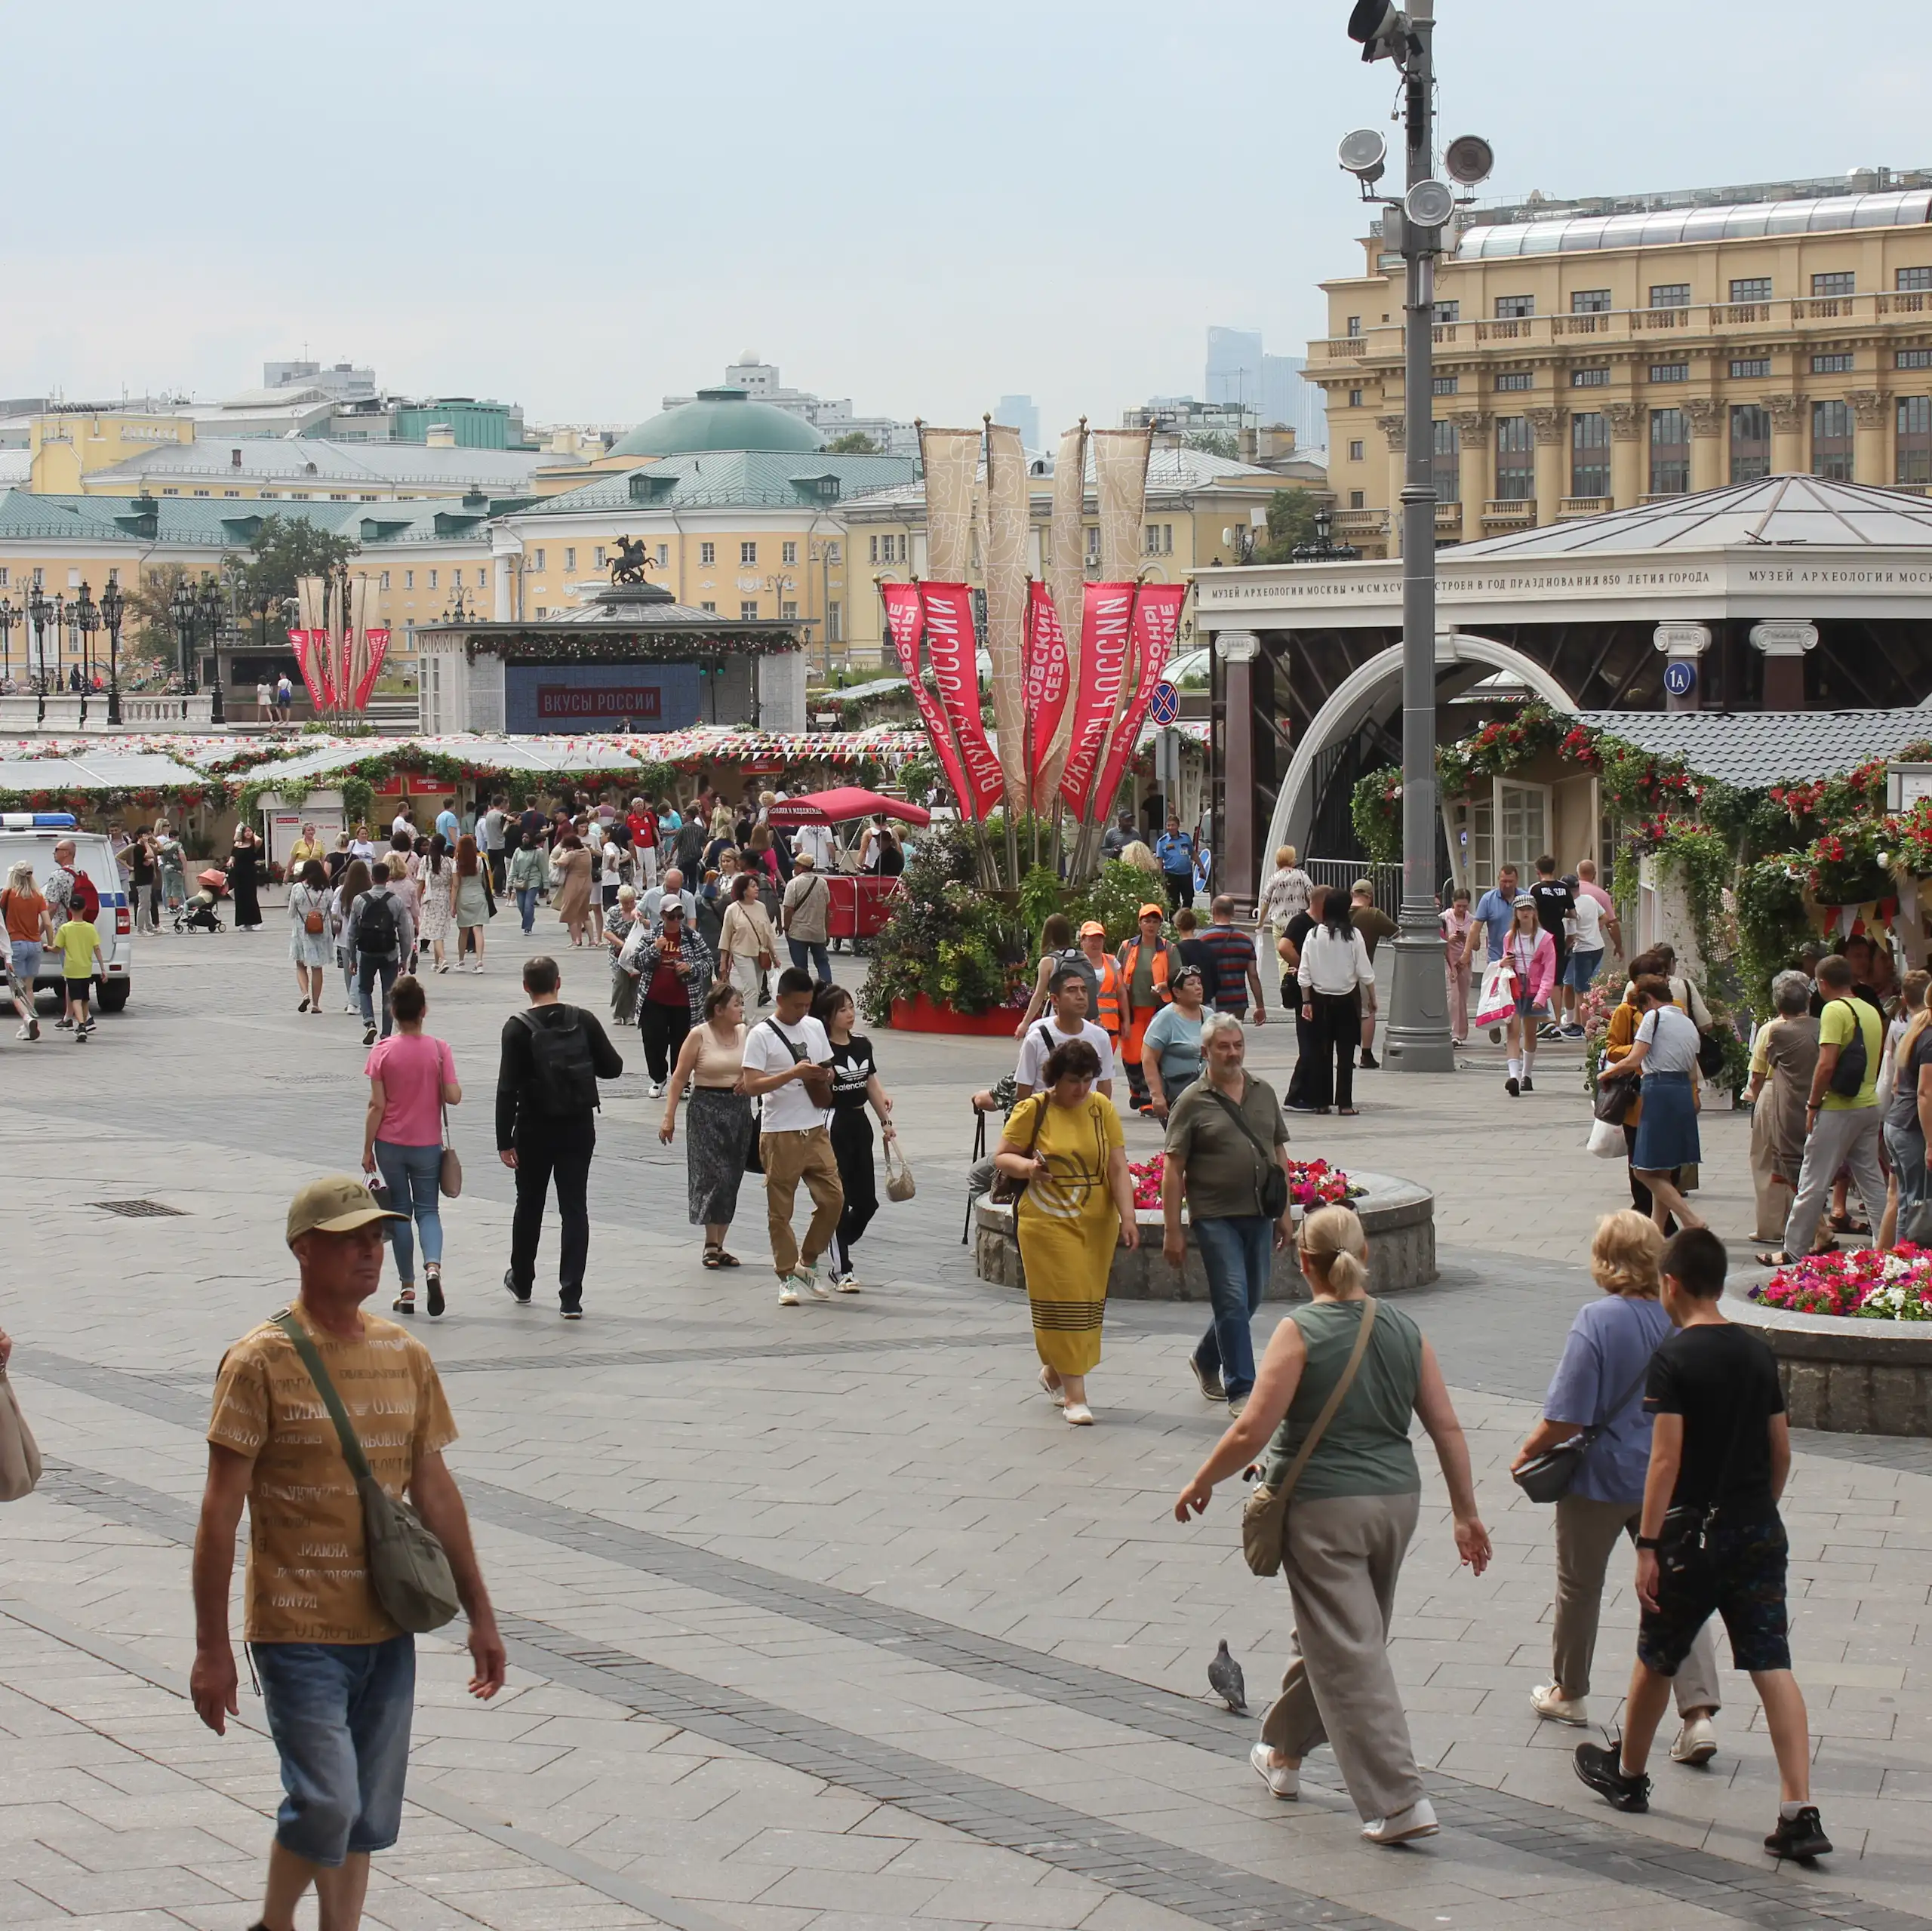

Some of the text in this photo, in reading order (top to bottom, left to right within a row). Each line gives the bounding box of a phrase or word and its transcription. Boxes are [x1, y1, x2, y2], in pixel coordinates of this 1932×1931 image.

[1211, 571, 1710, 598] МУЗЕЙ АРХЕОЛОГИИ МОСКВЫ MCMXCV СТРОЕН В ГОД ПРАЗДНОВАНИЯ 850 ЛЕТИЯ ГОРОДА
[1749, 568, 1794, 582] МУЗЕЙ
[1801, 571, 1894, 583] АРХЕОЛОГИИ
[926, 595, 965, 708] РОССИИ
[1044, 606, 1064, 703] СЕЗОНЫ
[544, 693, 654, 712] ВКУСЫ РОССИИ
